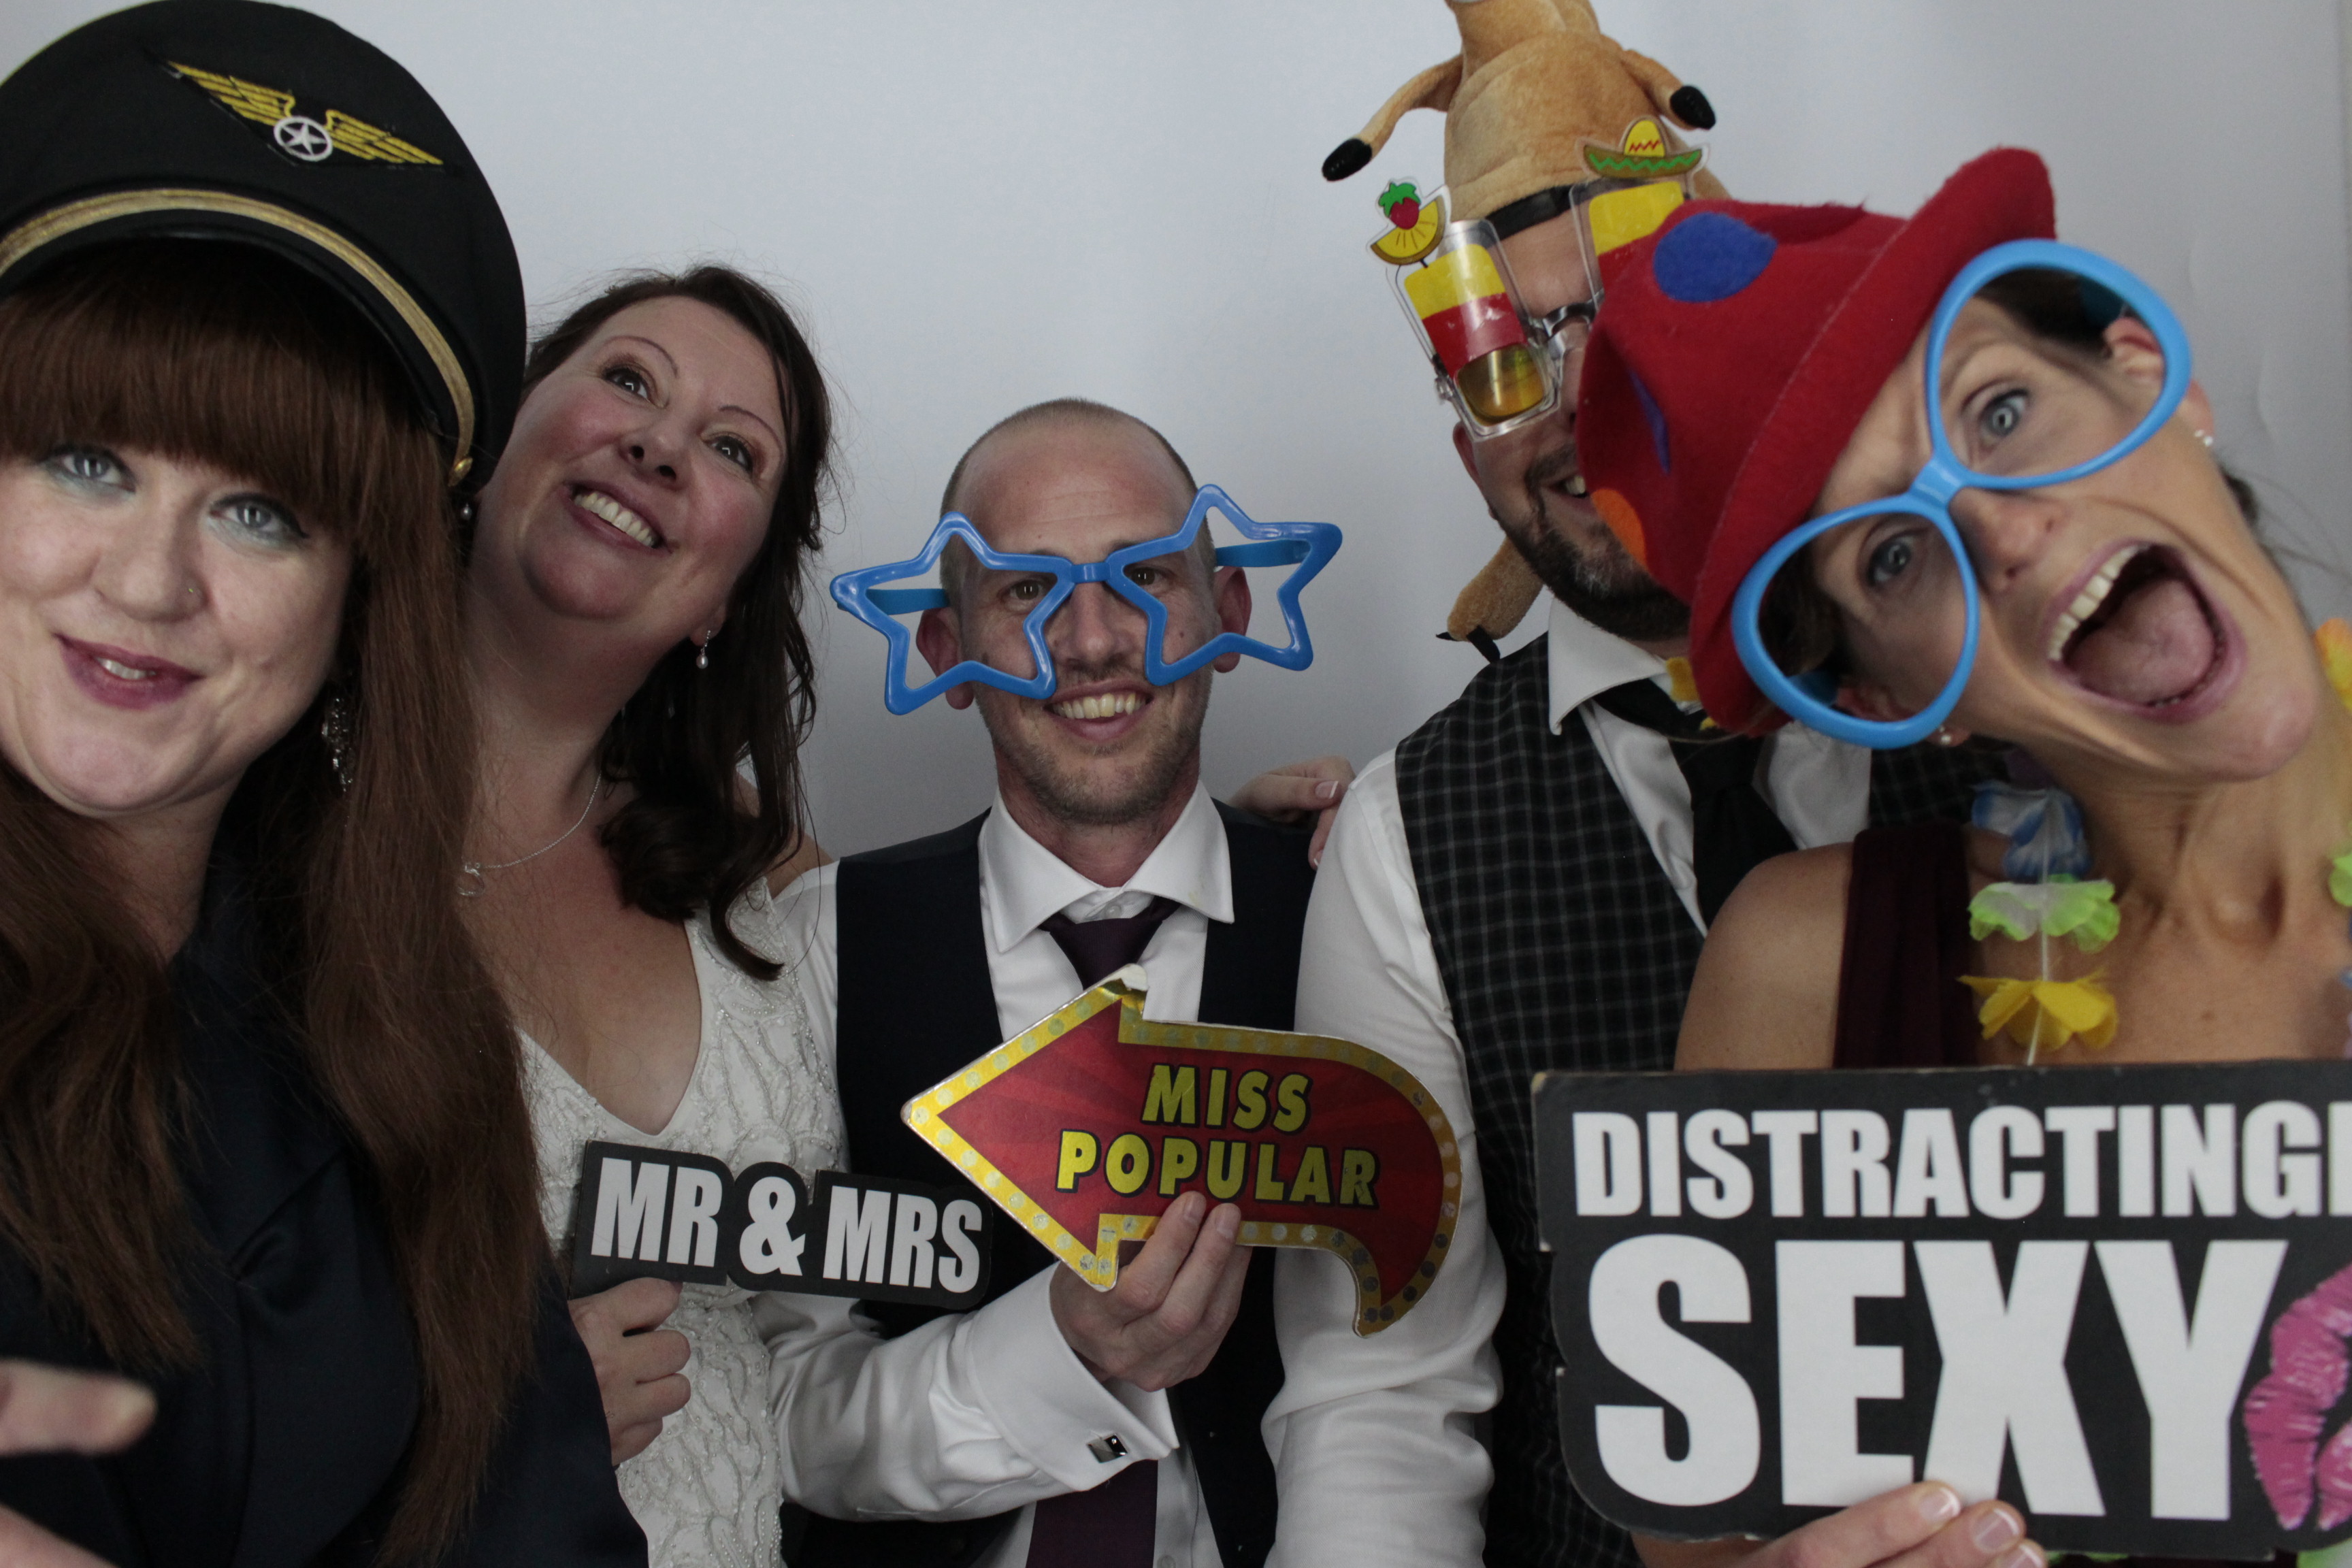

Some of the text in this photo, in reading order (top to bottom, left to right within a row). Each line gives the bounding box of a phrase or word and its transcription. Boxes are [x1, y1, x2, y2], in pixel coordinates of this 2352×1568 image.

[1142, 1064, 1312, 1132] MISS
[1056, 1130, 1379, 1209] POPULAR
[591, 1156, 983, 1293] MR & MRS
[1588, 1234, 2289, 1520] SEXY
